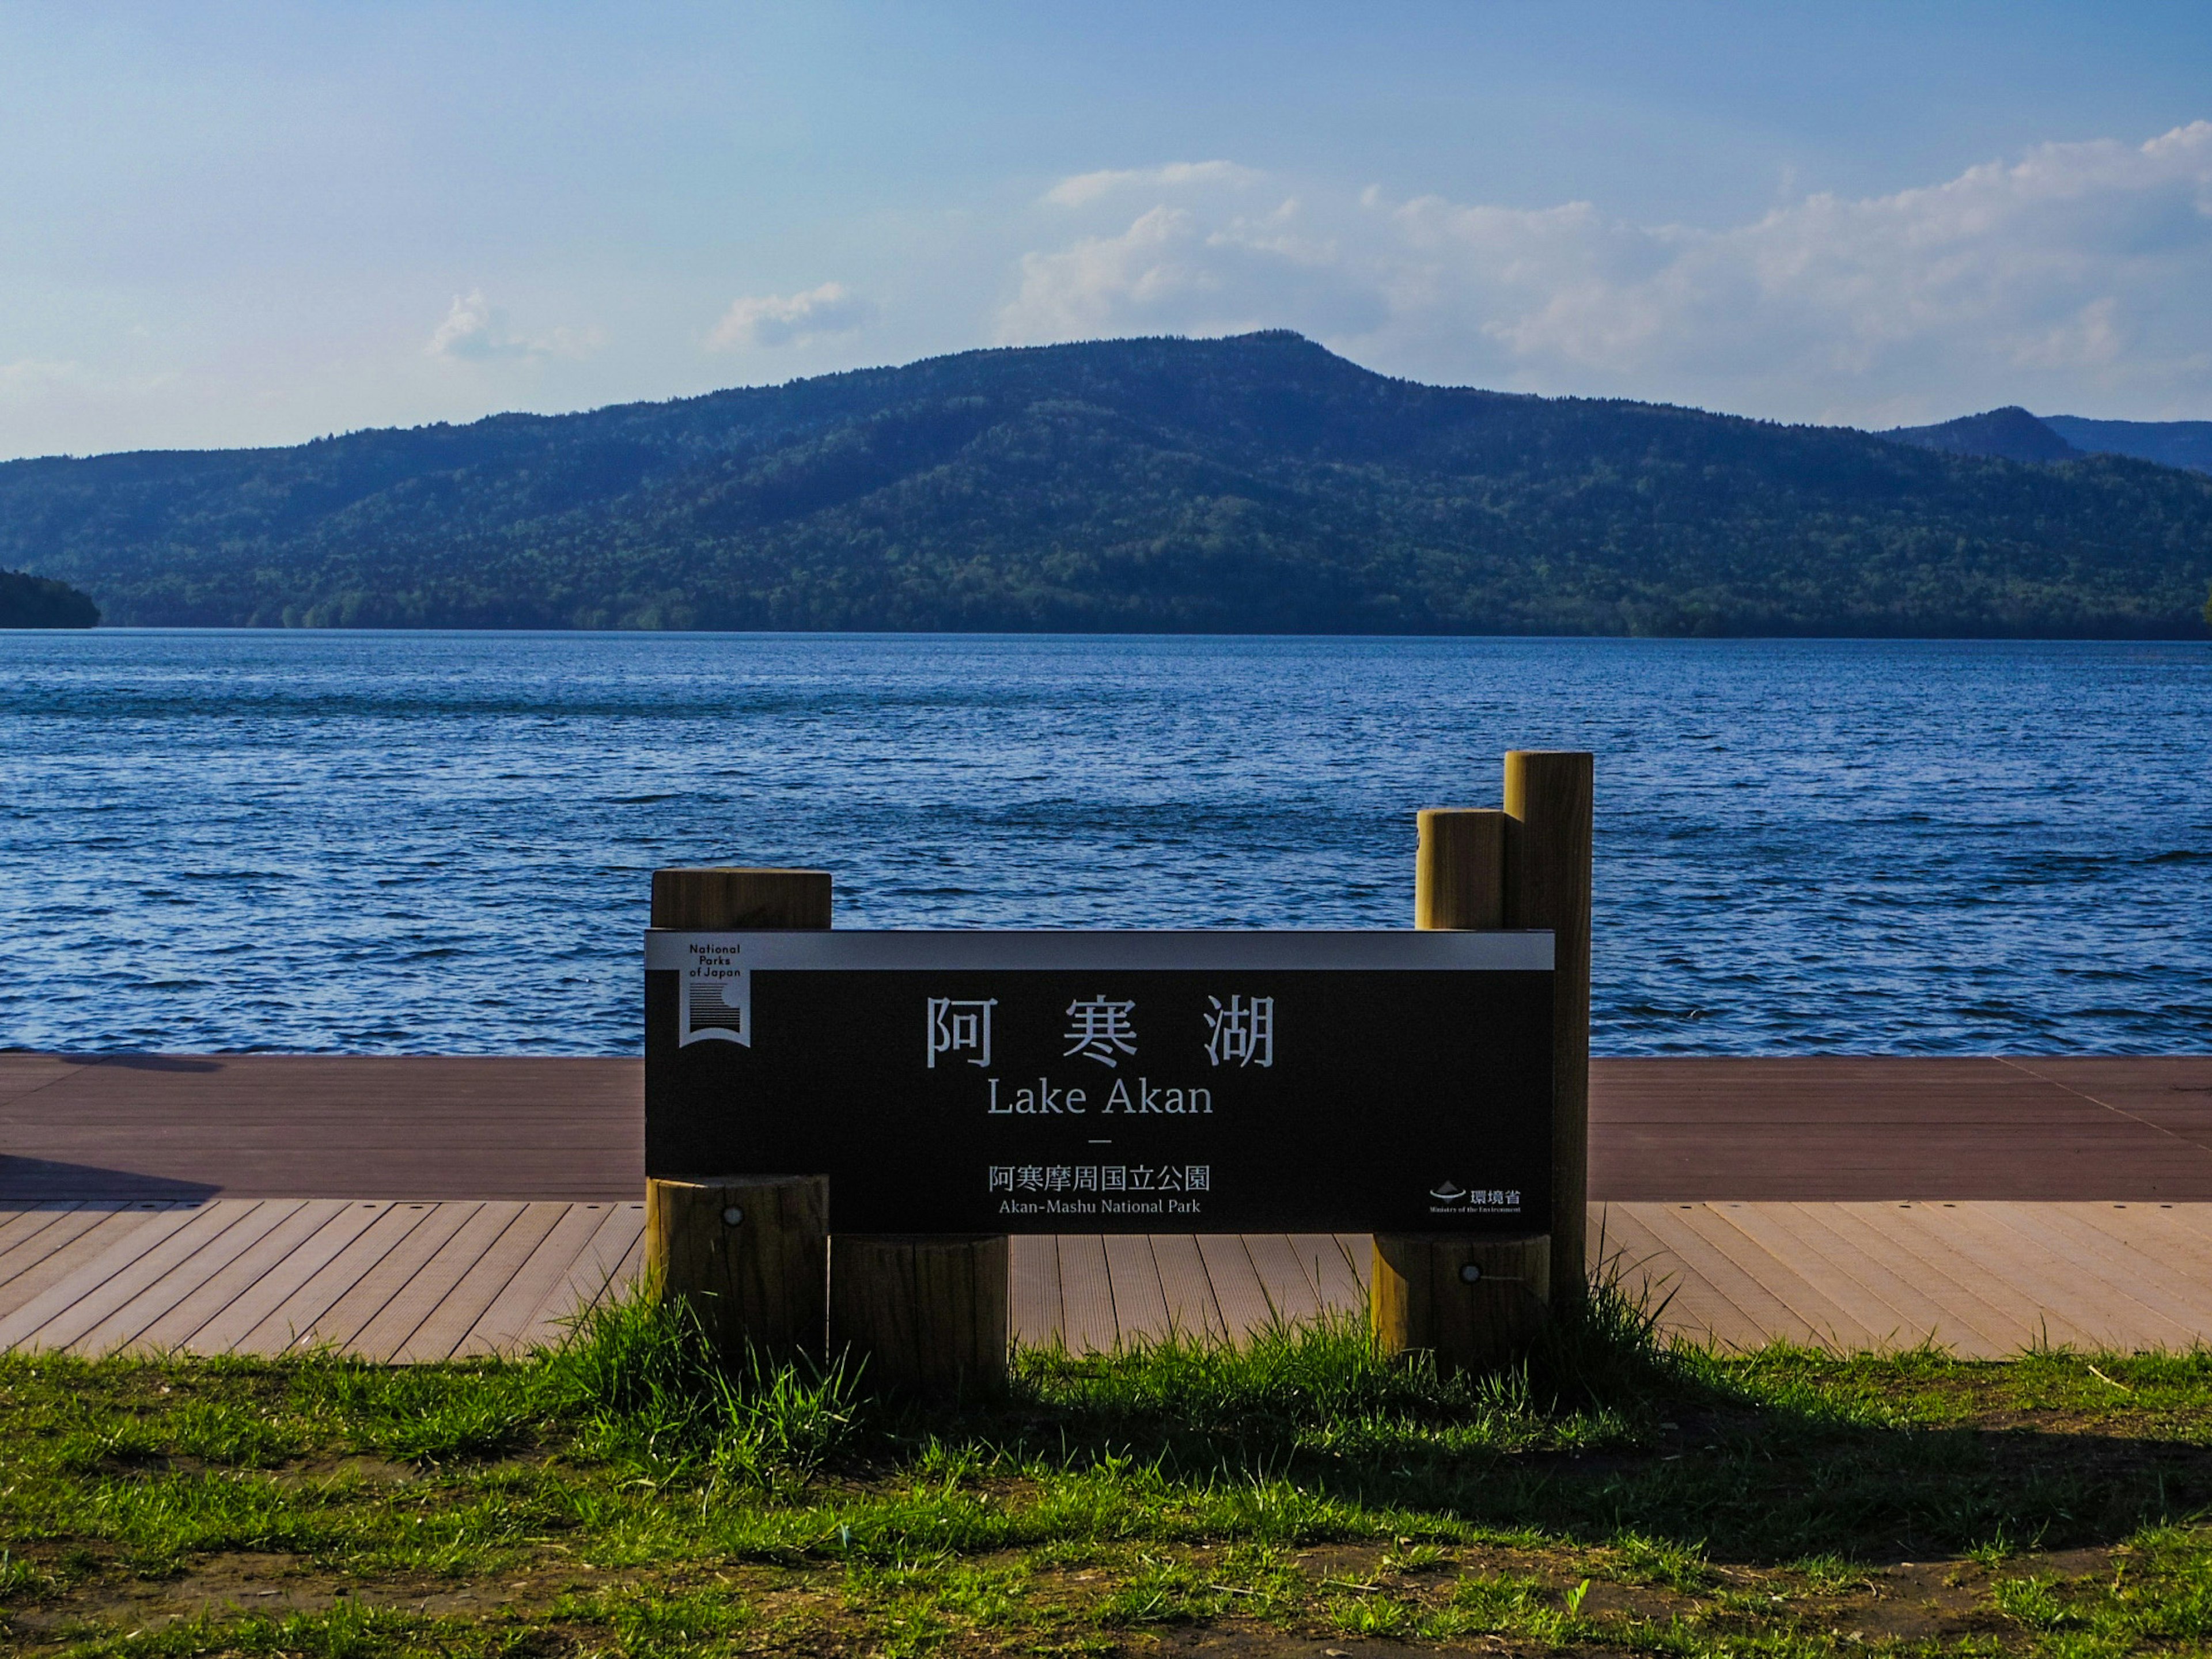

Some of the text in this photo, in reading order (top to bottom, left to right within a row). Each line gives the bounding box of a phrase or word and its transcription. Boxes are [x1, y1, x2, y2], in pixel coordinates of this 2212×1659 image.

[690, 944, 740, 954] National
[699, 956, 730, 965] Parks
[690, 967, 741, 979] of Japan
[927, 994, 1274, 1068] 阿寒湖
[988, 1077, 1213, 1113] Lake Akan
[989, 1165, 1210, 1192] 阿寒摩周国立公園
[1471, 1190, 1521, 1205] 環境省
[999, 1199, 1201, 1213] Akan-Mashu National Park
